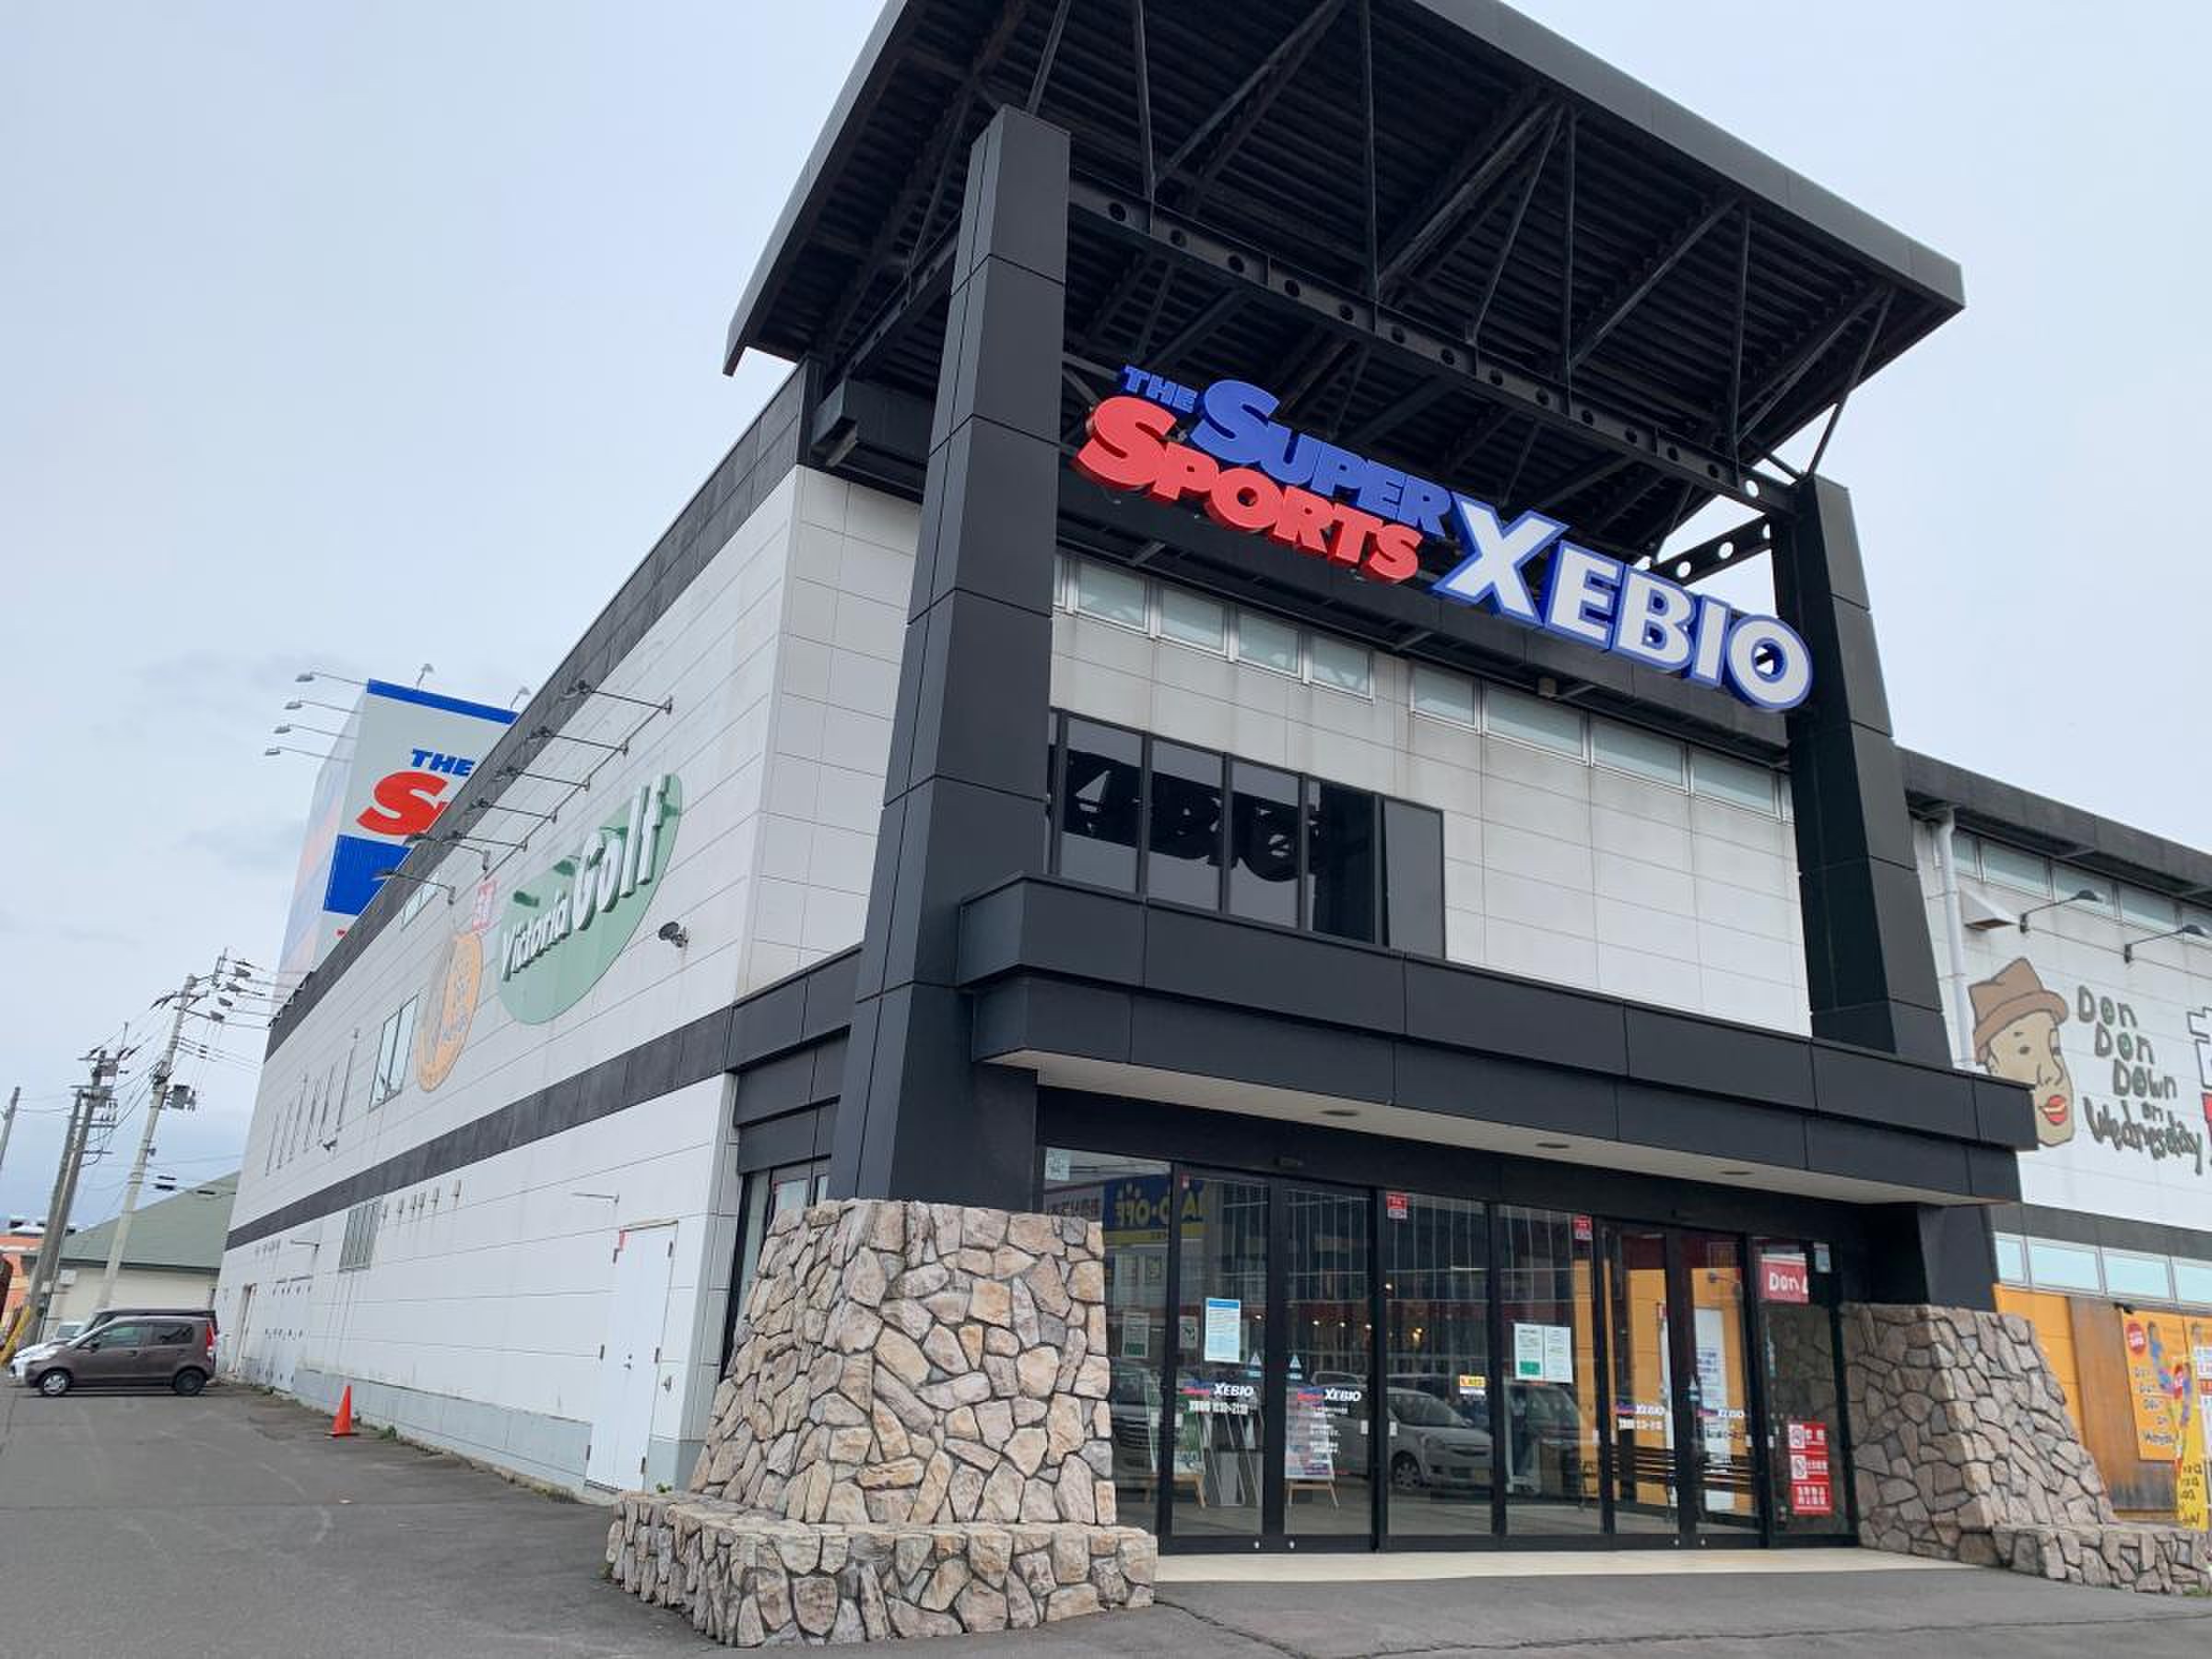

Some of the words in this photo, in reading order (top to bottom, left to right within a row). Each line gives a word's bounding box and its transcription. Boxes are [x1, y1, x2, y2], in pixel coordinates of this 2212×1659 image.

[1124, 365, 1198, 415] THE
[1190, 379, 1453, 538] SUPER
[1077, 395, 1424, 585] SPORTS
[1430, 488, 1814, 712] XEBIO
[411, 748, 475, 777] THE
[502, 887, 573, 982] Victoria
[571, 772, 672, 932] Golf
[2077, 985, 2137, 1028] Don
[2095, 1021, 2155, 1065] Don
[2112, 1058, 2178, 1100] Down
[2140, 1101, 2164, 1122] on
[1769, 1272, 1800, 1292] Don
[1213, 1382, 1254, 1397] XEBIO
[1324, 1388, 1362, 1402] XEBIO
